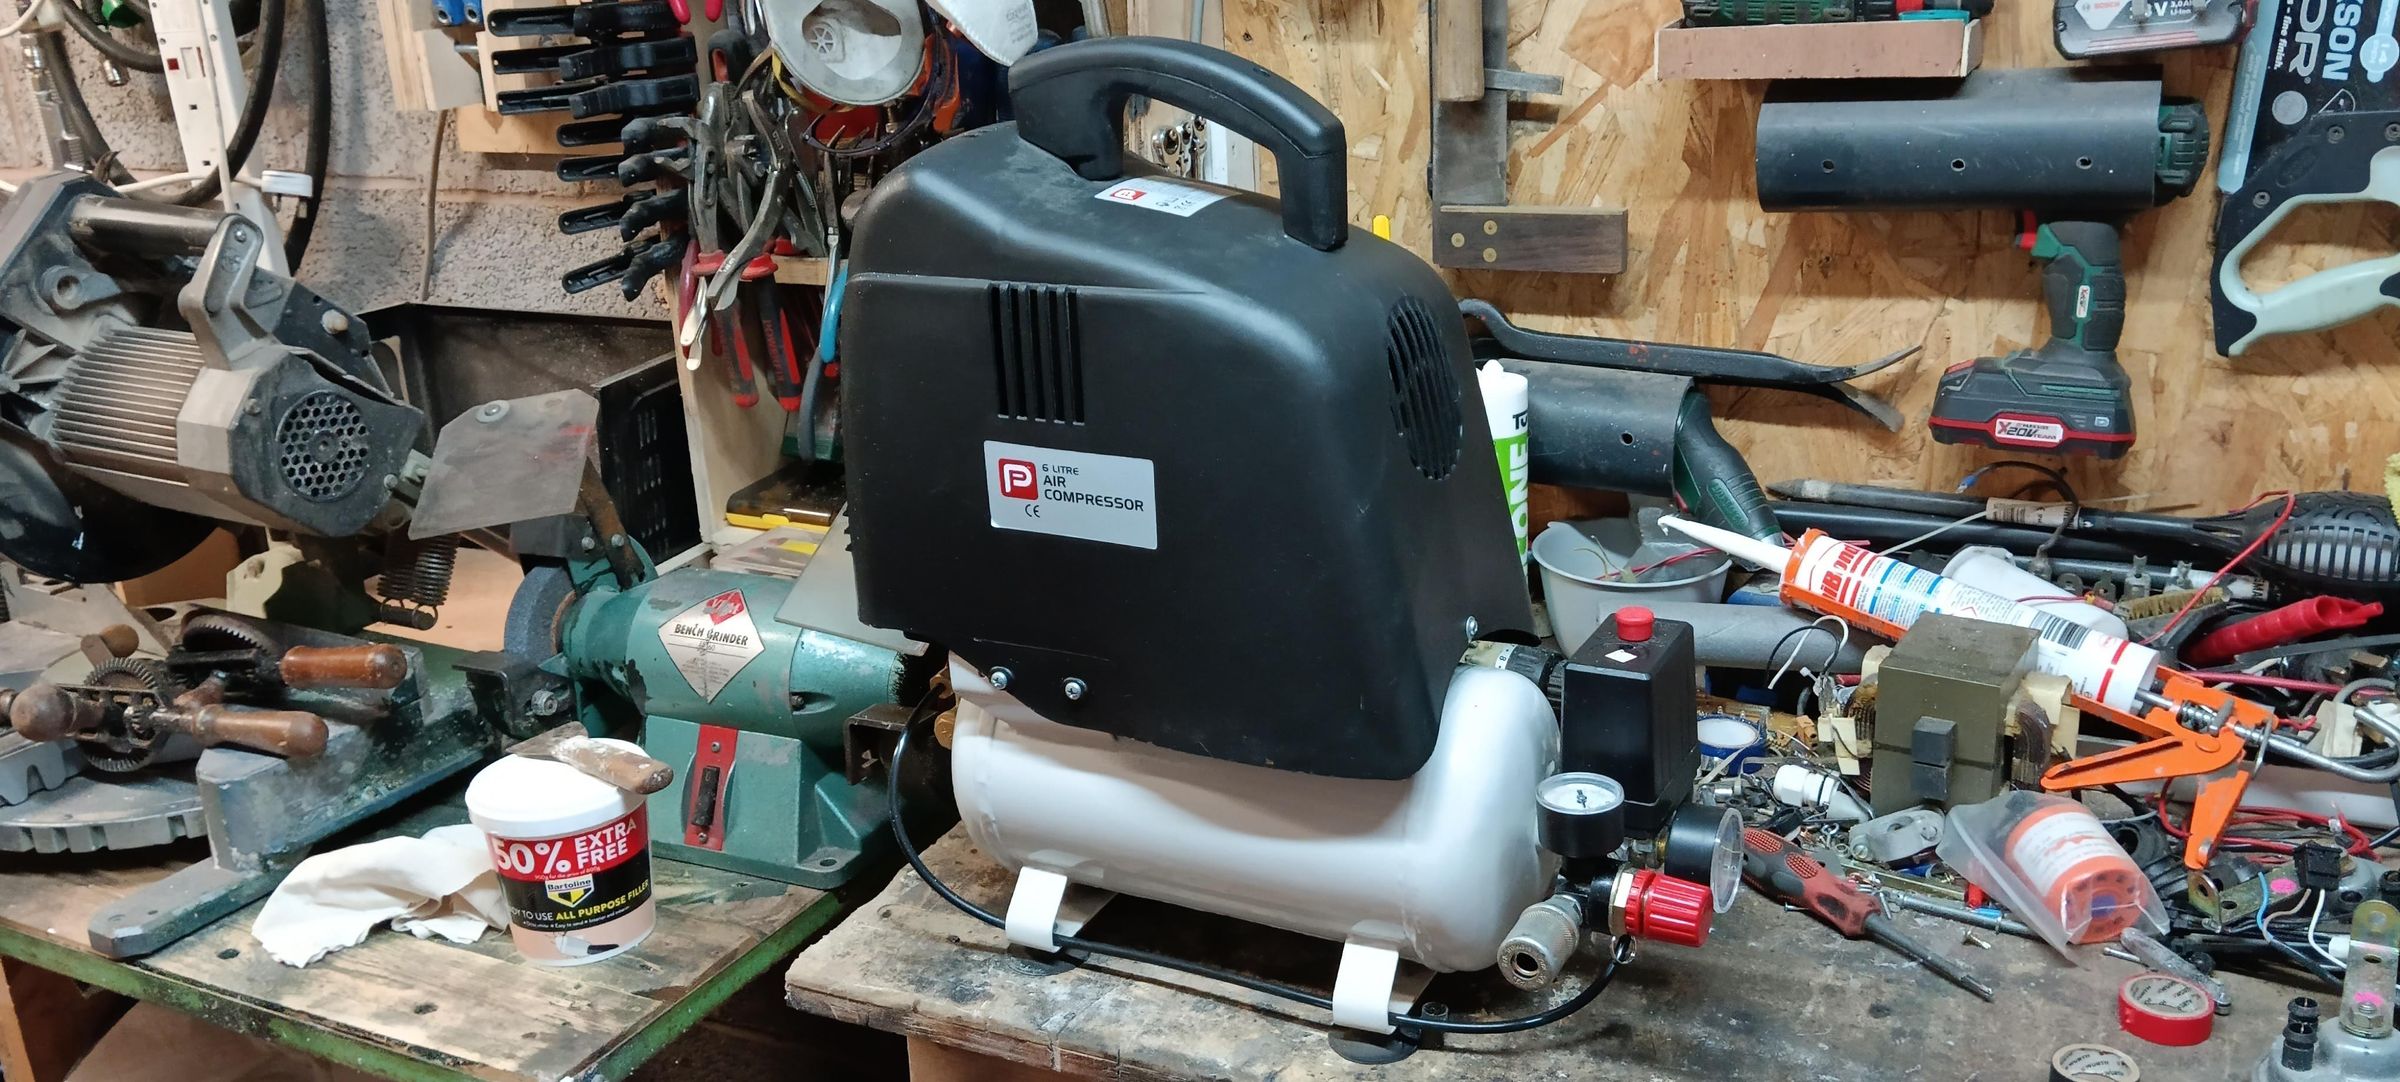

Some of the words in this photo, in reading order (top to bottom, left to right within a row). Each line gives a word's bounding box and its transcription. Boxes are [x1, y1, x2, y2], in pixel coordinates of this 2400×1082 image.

[2321, 0, 2364, 81] SON
[1041, 463, 1049, 472] 6
[1052, 464, 1080, 476] LITRE
[1043, 475, 1067, 488] AIR
[1043, 488, 1144, 512] COMPRESSOR
[674, 623, 705, 637] BENCH
[706, 629, 749, 646] GRINDER
[574, 816, 637, 854] EXTRA
[492, 838, 572, 875] 50%
[576, 837, 629, 870] FREE
[547, 878, 592, 892] Bartoline
[521, 910, 534, 920] TO
[536, 912, 554, 922] USE
[555, 910, 577, 921] ALL
[578, 895, 628, 918] PURPOSE
[627, 879, 650, 901] FILLER
